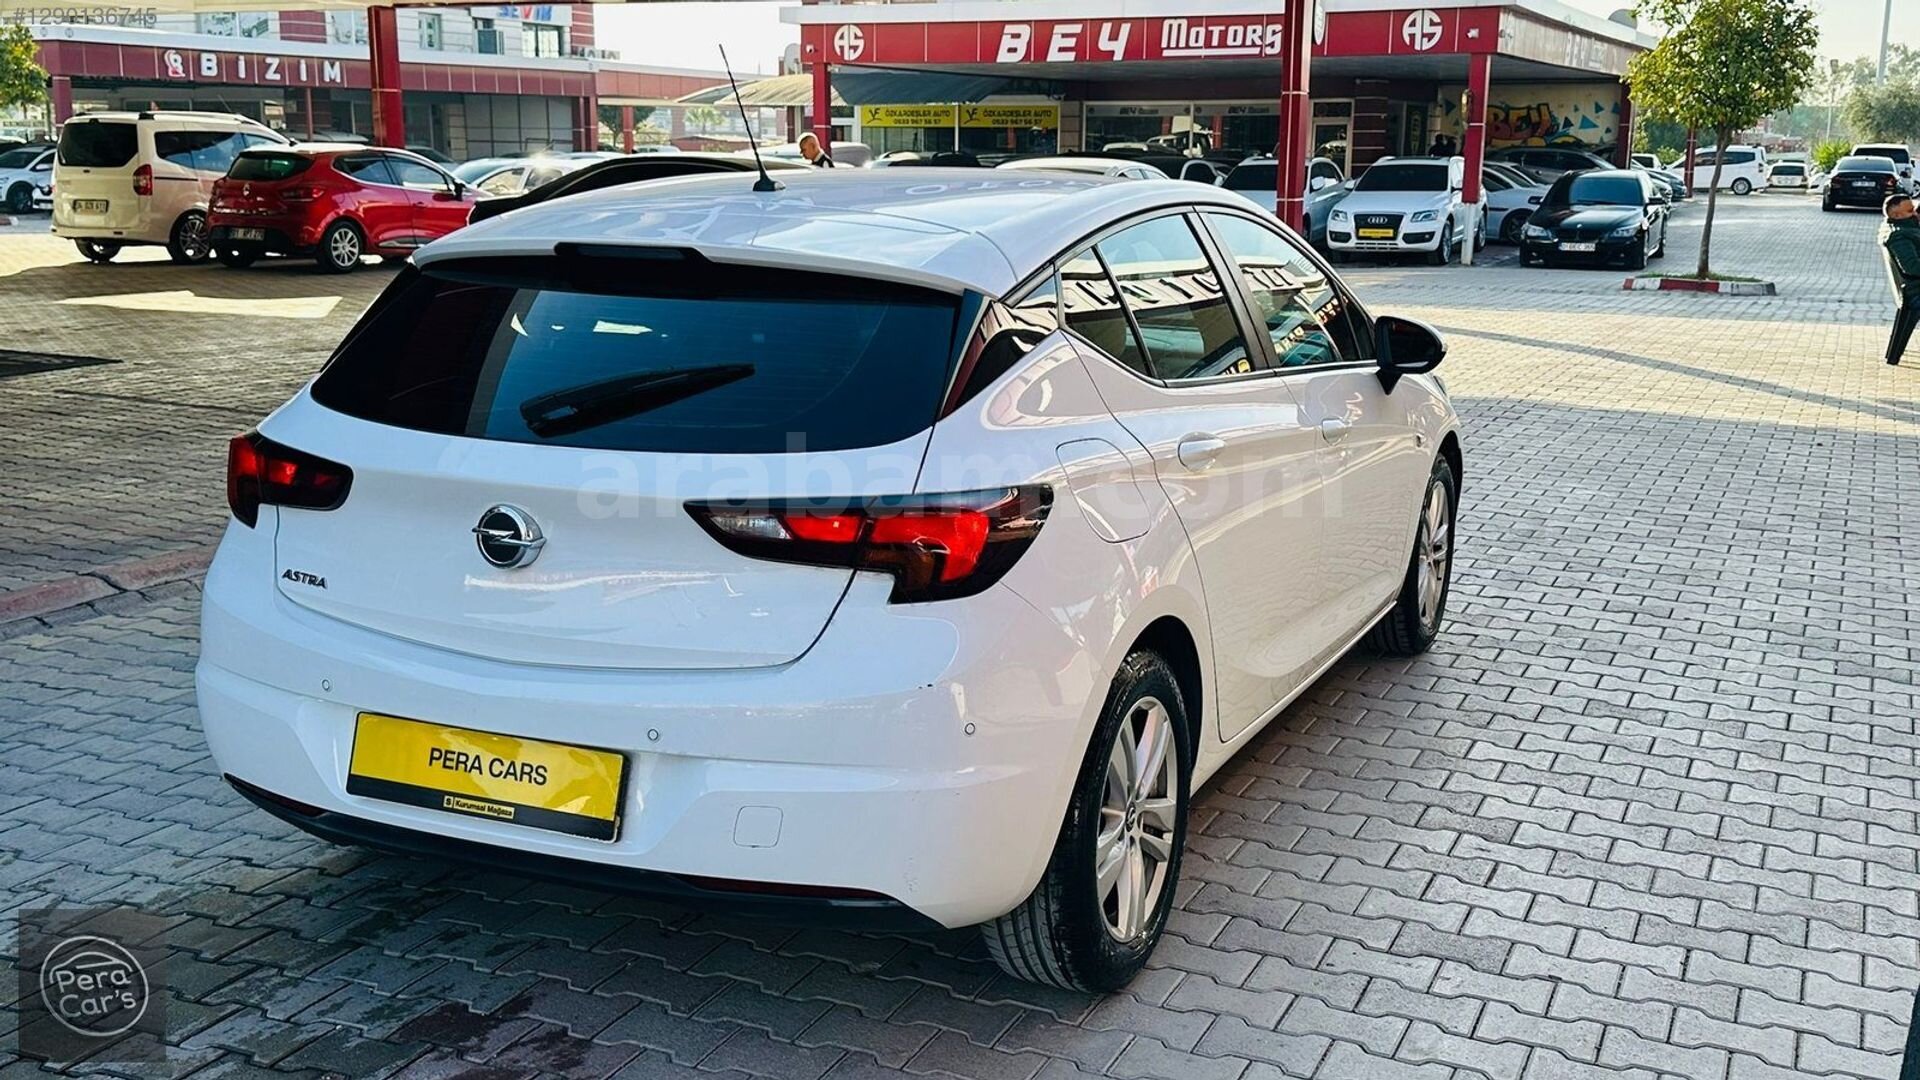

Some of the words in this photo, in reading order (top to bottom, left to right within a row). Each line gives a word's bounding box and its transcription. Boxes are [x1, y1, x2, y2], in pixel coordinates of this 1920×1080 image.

[932, 109, 950, 118] AUTO
[1033, 109, 1052, 118] AUTO
[281, 568, 327, 589] ASTRA
[428, 746, 484, 775] PERA
[488, 757, 548, 786] CARS
[455, 800, 486, 811] Kurumsal
